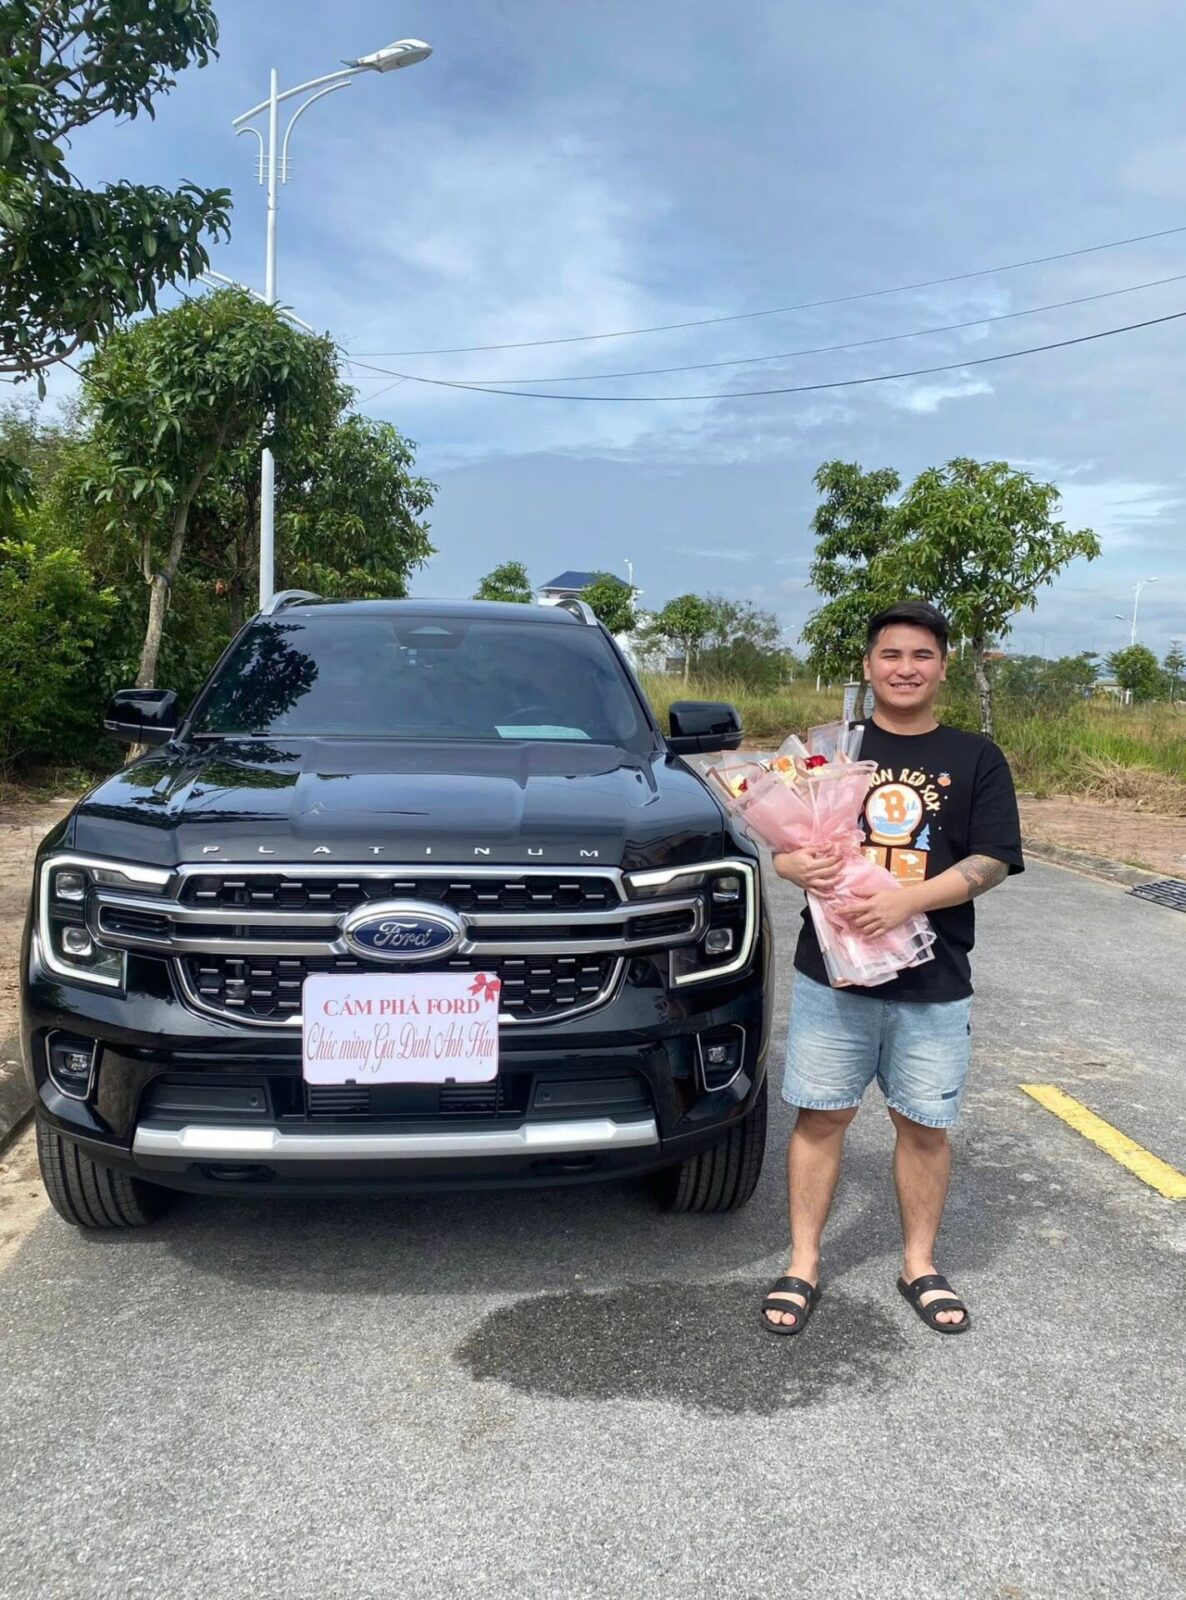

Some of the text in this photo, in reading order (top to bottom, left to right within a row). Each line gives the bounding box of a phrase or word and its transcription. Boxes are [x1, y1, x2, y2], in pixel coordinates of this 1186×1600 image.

[869, 768, 941, 811] ON RED SOX
[880, 790, 907, 824] B
[202, 845, 600, 858] PLATINUM
[373, 921, 432, 946] Ford
[427, 998, 481, 1015] FORD
[307, 1022, 338, 1061] Chúc
[339, 1029, 372, 1072] mừng
[371, 1022, 395, 1074] Gia
[434, 1021, 464, 1060] Anh
